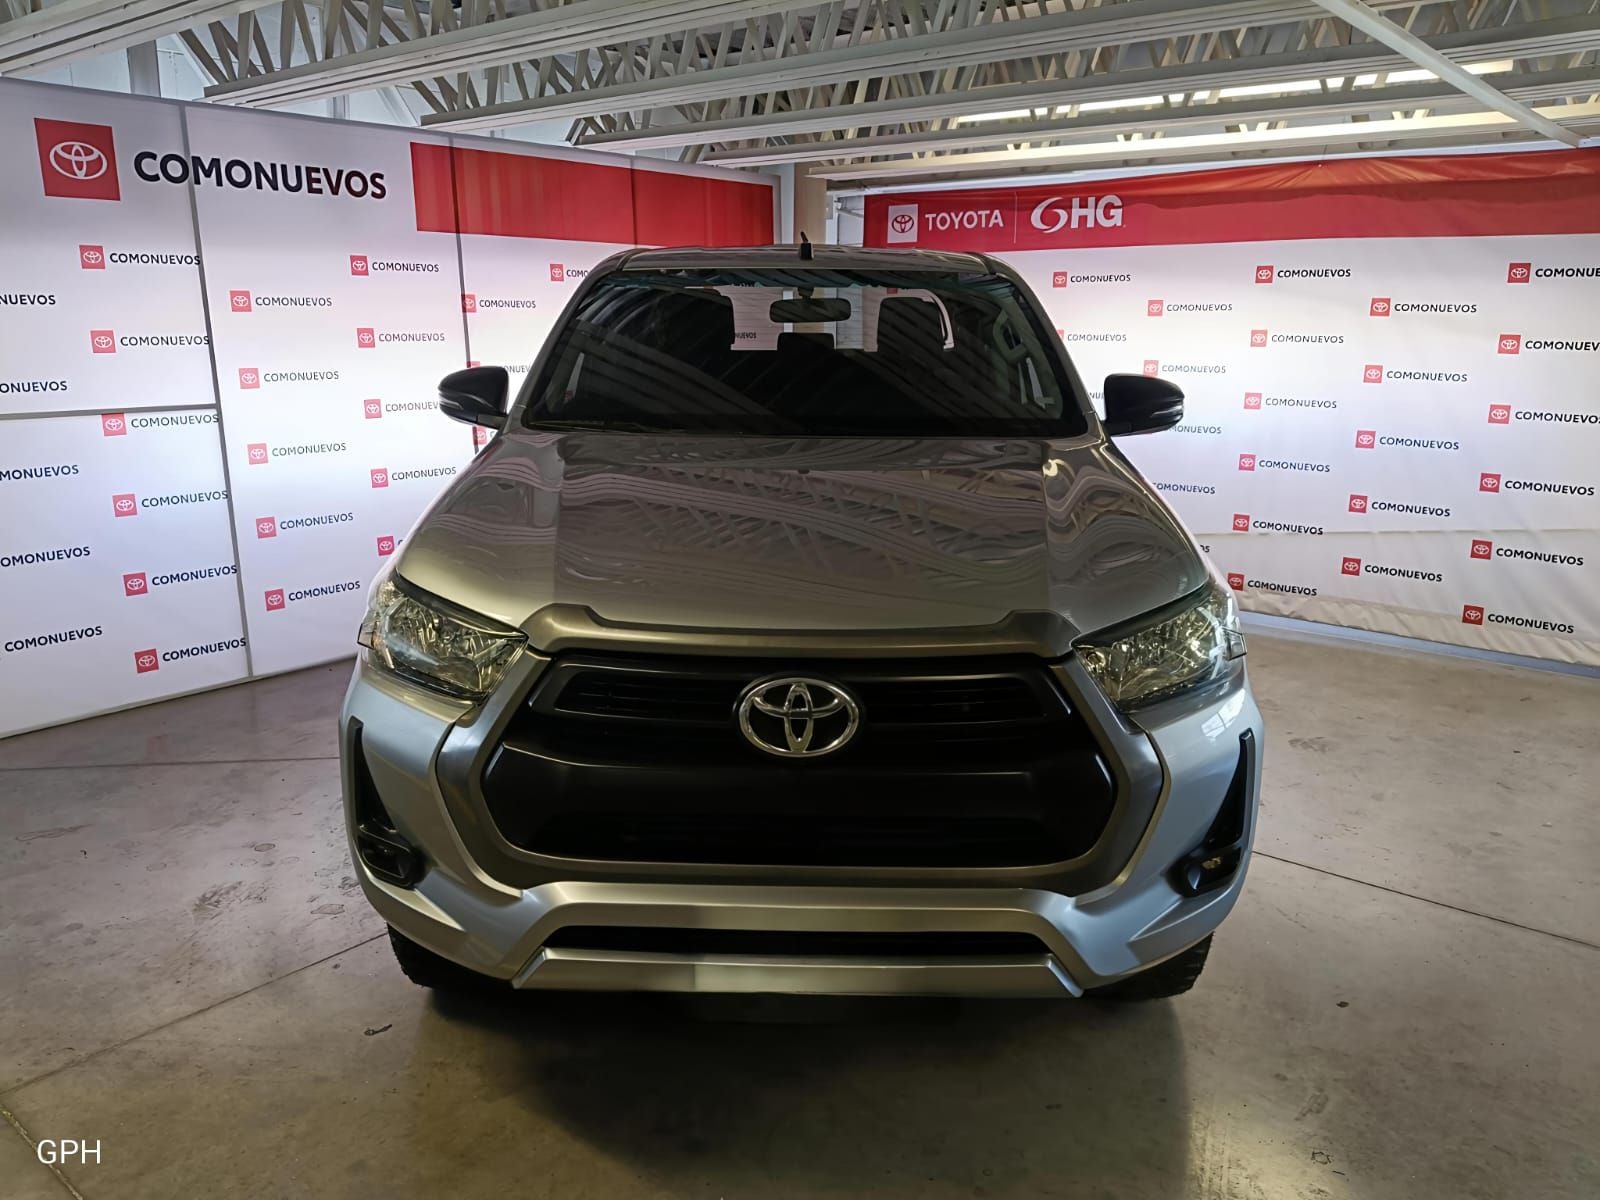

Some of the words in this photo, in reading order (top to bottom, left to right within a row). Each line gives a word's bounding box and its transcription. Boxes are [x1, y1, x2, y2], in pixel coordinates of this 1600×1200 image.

[133, 151, 387, 199] COMONUEVOS
[924, 210, 1004, 230] TOYOTA
[109, 252, 200, 265] COMONUEVOS
[371, 261, 440, 273] COMONUEVOS
[1277, 268, 1351, 279] COMONUEVOS
[1070, 273, 1131, 283] COMONUEVOS
[255, 296, 333, 307] COMONUEVOS
[478, 299, 537, 309] COMONUEVOS
[1166, 303, 1233, 312] COMONUEVOS
[1394, 303, 1477, 313] COMONUEVOS
[120, 335, 210, 346] COMONUEVOS
[378, 332, 445, 343] COMONUEVOS
[1067, 333, 1127, 342] COMONUEVOS
[1271, 334, 1344, 344] COMONUEVOS
[1161, 364, 1227, 374] COMONUEVOS
[263, 370, 340, 383] COMONUEVOS
[1386, 370, 1468, 383] COMONUEVOS
[0, 380, 68, 394] ONUEVOS
[1265, 397, 1337, 409] COMONUEVOS
[130, 413, 219, 428] COMONUEVOS
[1514, 411, 1600, 424] COMONUEVO
[271, 442, 347, 457] COMONUEVOS
[1379, 436, 1460, 451] COMONUEVOS
[391, 466, 457, 480] COMONUEVOS
[1258, 459, 1331, 473] COMONUEVOS
[1504, 480, 1595, 496] COMONUEVOS
[141, 490, 229, 508] COMONUEVOS
[1371, 502, 1451, 517] COMONUEVOS
[279, 512, 354, 529] COMONUEVOS
[1252, 520, 1324, 536] COMONUEVOS
[1495, 548, 1584, 566] COMONUEVOS
[151, 565, 238, 586] COMONUEVOS
[1364, 565, 1443, 582] COMONUEVOS
[288, 581, 361, 601] COMONUEVOS
[1247, 580, 1318, 596] COMONUEVOS
[1487, 614, 1575, 633] COMONUEVOS
[4, 626, 103, 652] COMONUEVOS
[162, 638, 247, 662] COMONUEVOS
